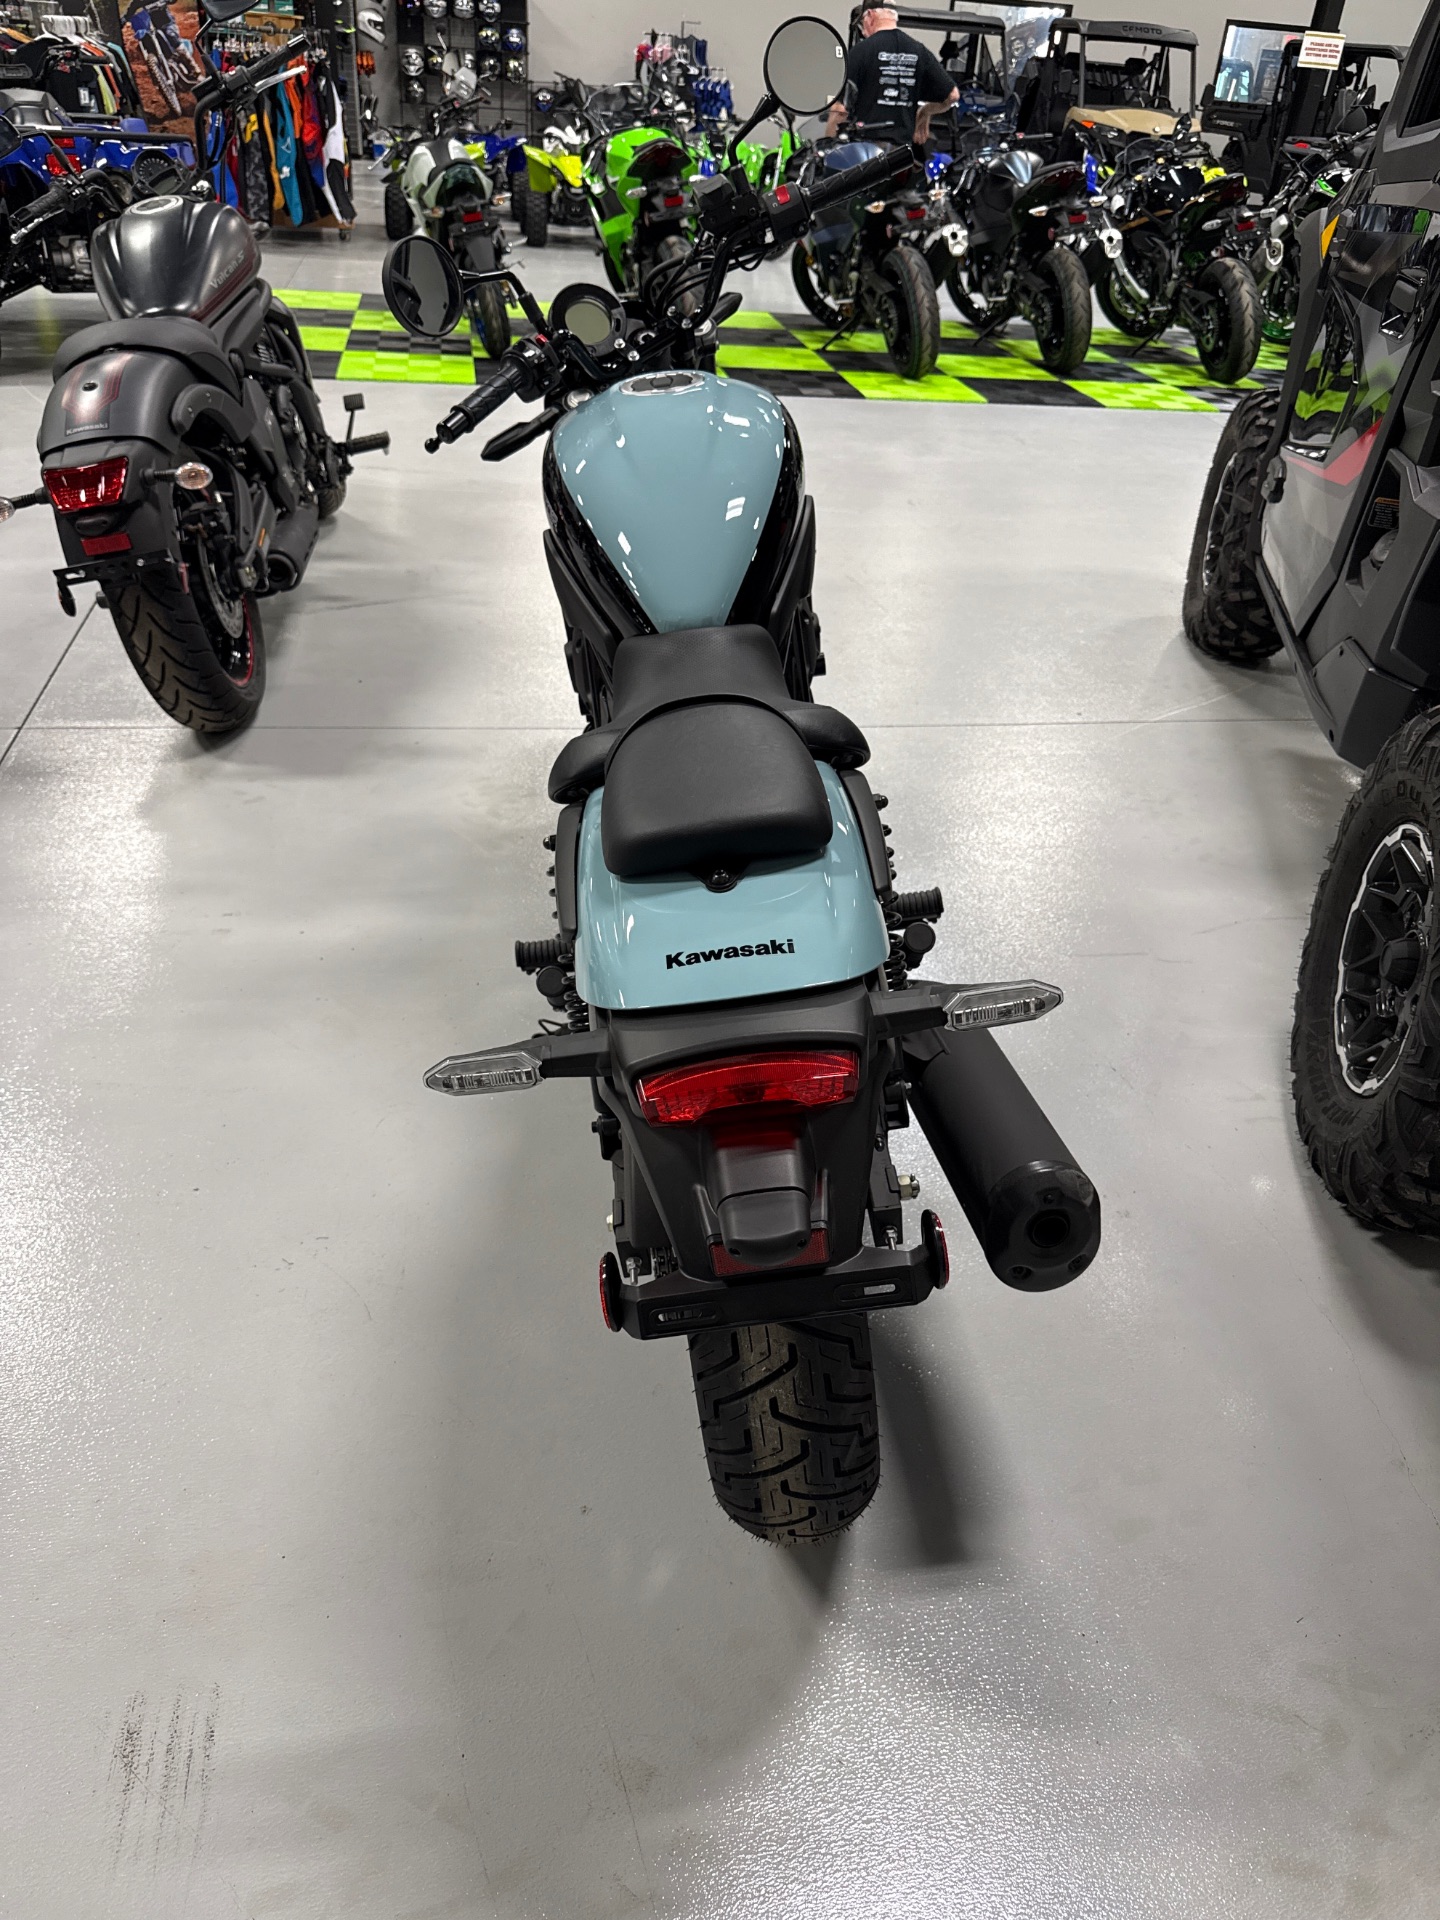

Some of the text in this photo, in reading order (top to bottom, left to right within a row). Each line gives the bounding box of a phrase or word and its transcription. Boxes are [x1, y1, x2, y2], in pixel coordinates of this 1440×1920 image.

[1121, 25, 1163, 35] CFMOTO
[210, 249, 245, 288] Vulcan S
[66, 423, 108, 436] Kawasaki
[665, 938, 796, 970] Kawasaki
